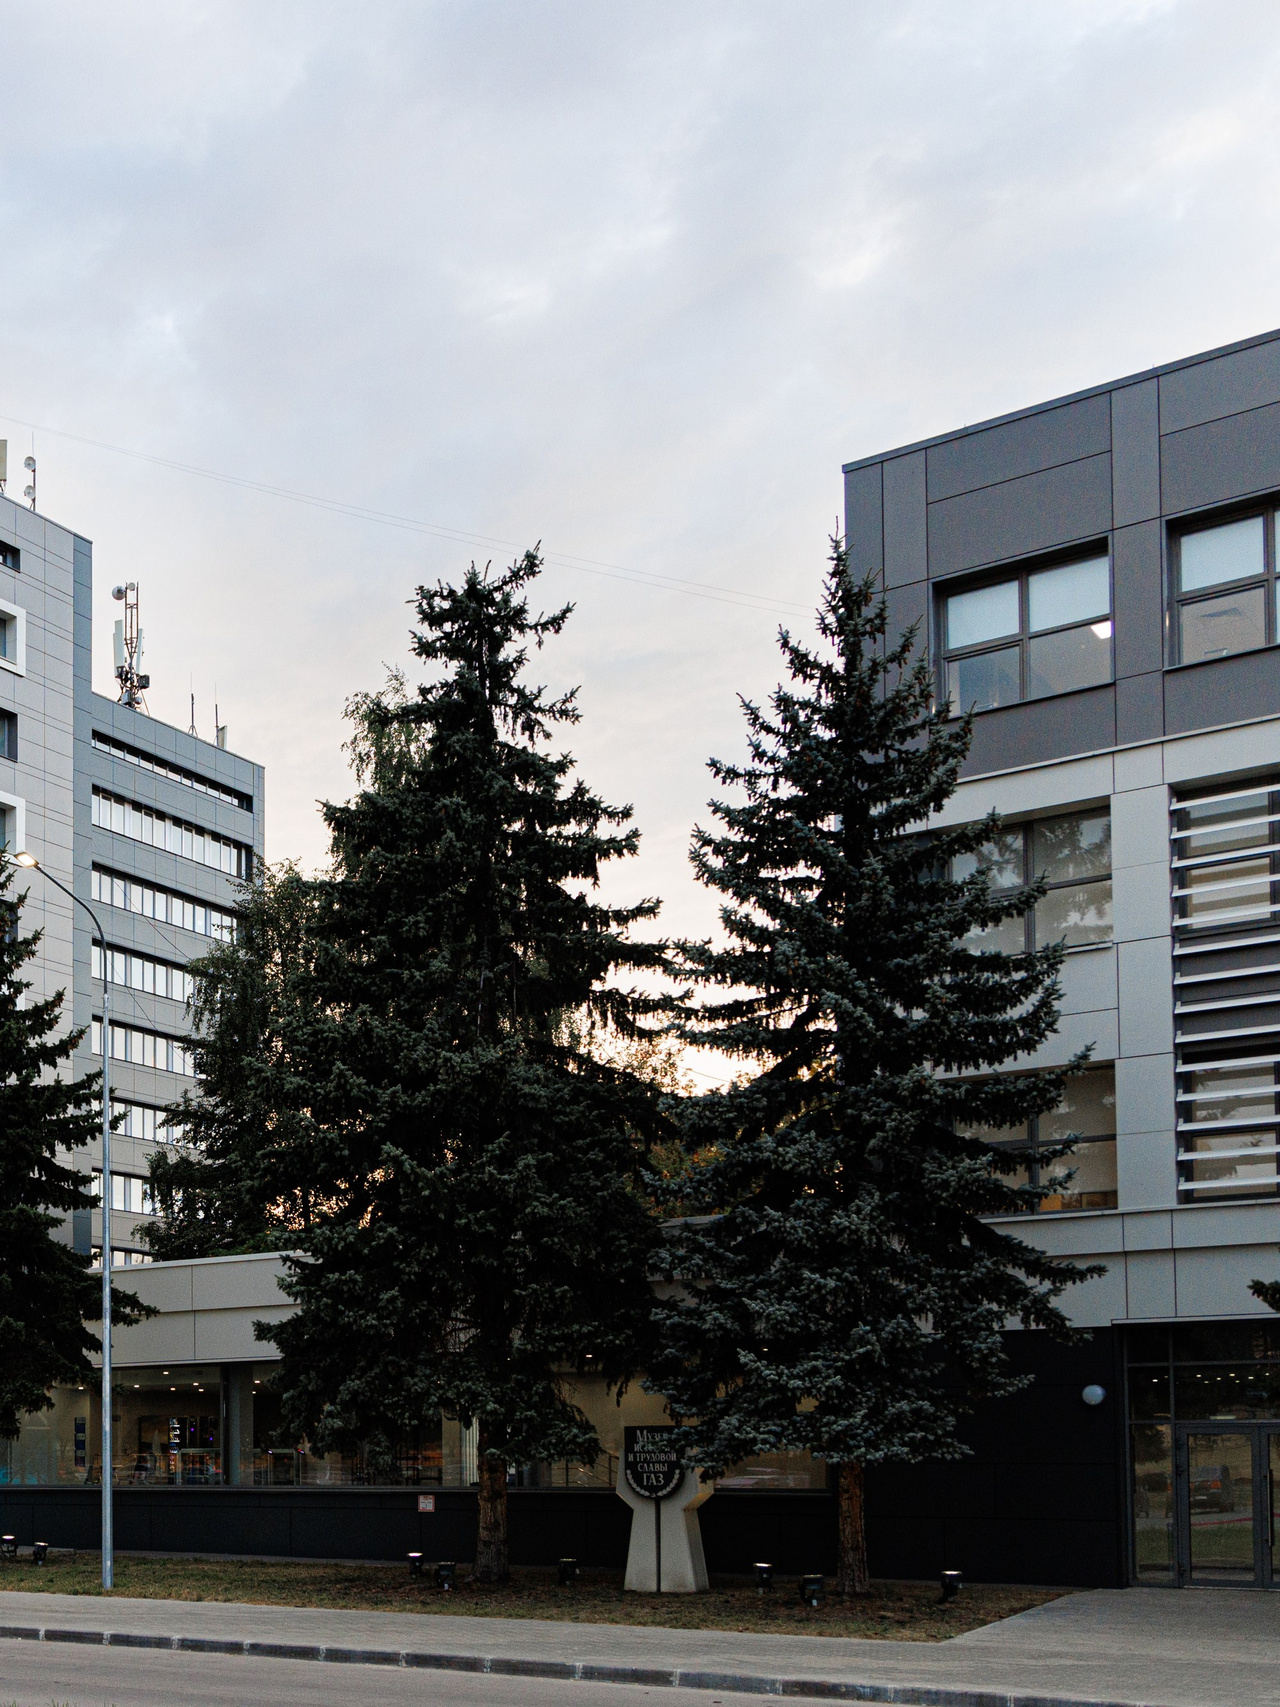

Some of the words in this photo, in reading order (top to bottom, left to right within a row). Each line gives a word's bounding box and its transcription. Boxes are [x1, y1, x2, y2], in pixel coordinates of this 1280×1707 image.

[635, 1451, 677, 1462] ТРУДОВОЙ
[637, 1463, 668, 1472] СЛАВЫ
[643, 1473, 665, 1486] ГАЗ
